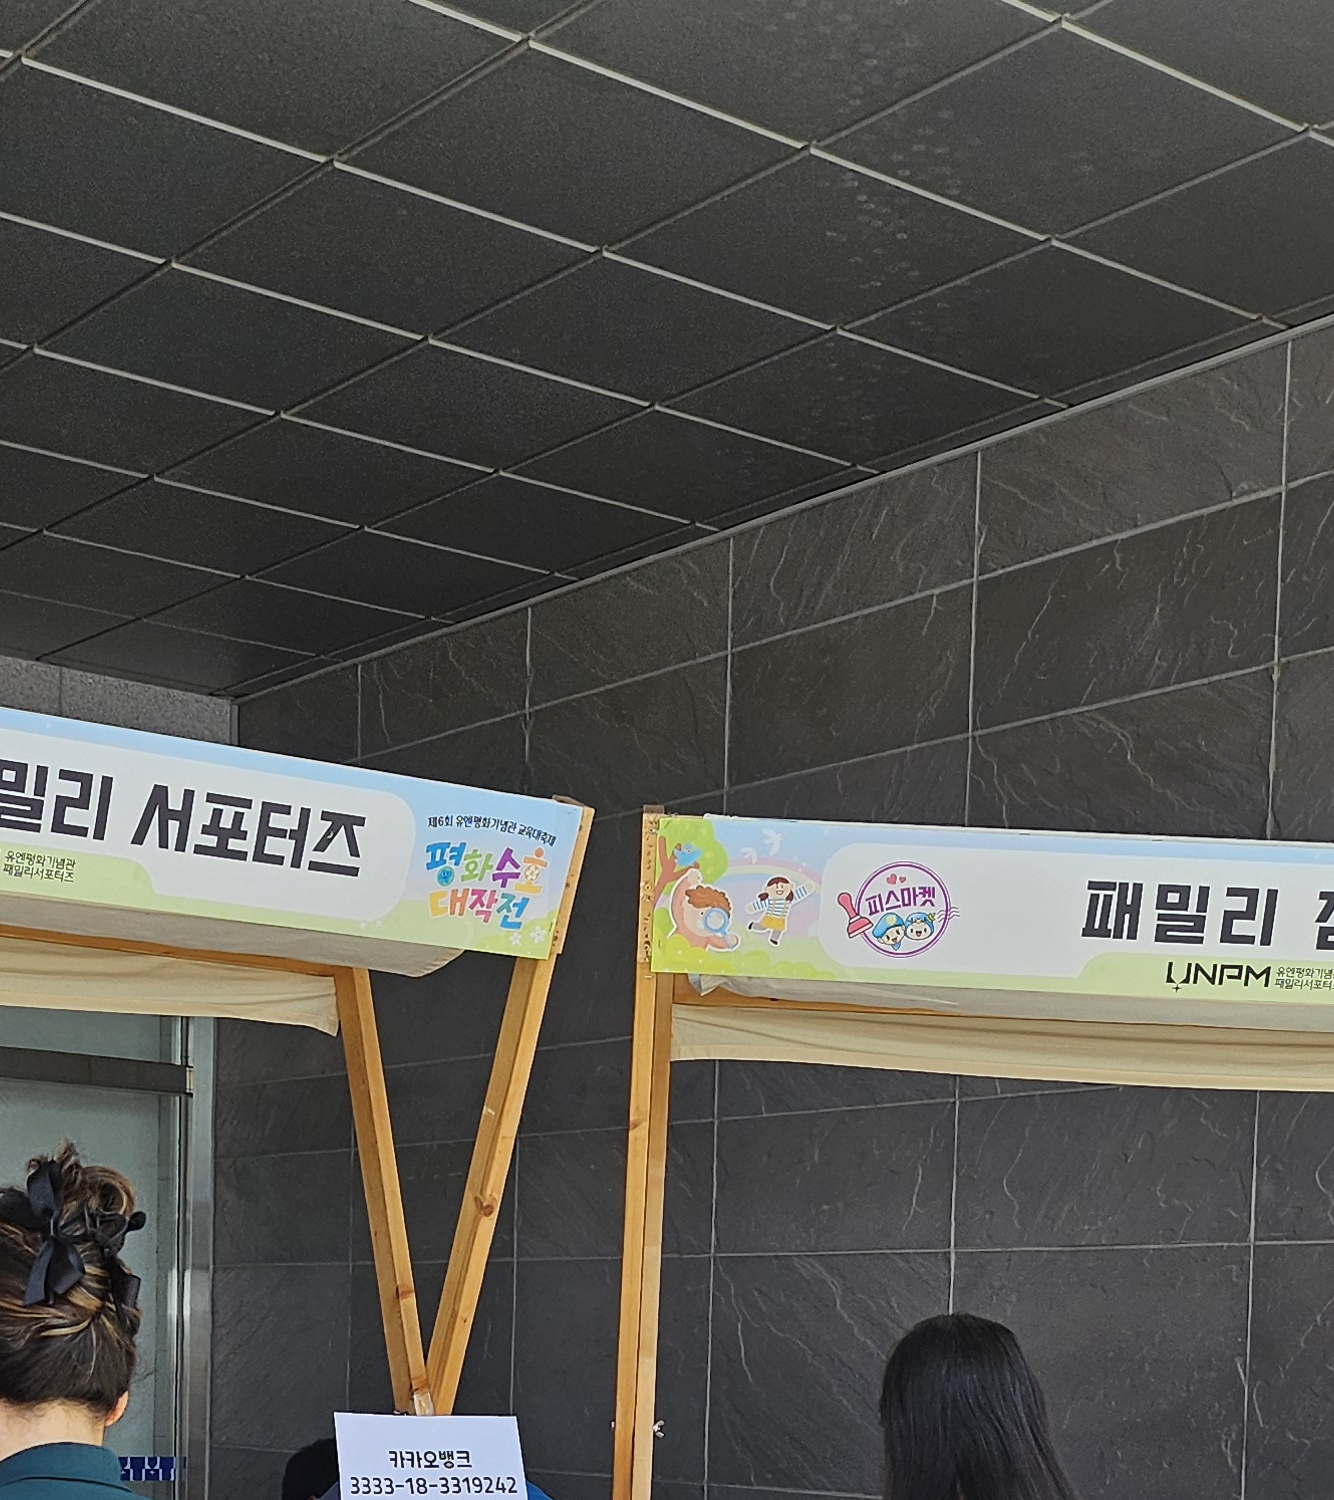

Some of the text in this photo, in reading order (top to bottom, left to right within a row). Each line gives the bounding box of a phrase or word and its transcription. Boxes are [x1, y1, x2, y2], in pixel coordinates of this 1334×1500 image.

[131, 784, 366, 877] 서포터즈
[428, 816, 453, 828] 제6회
[5, 850, 76, 869] 유엔평화기념관
[426, 842, 548, 895] 평화수호
[3, 863, 74, 883] 패밀리서포터즈
[429, 888, 529, 930] 대작전
[865, 886, 937, 917] 피스마켓
[1081, 879, 1278, 948] 패밀리
[1166, 962, 1271, 988] UNPM
[389, 1450, 472, 1469] 카카오뱅크
[351, 1477, 517, 1495] 3333-18-3319242
